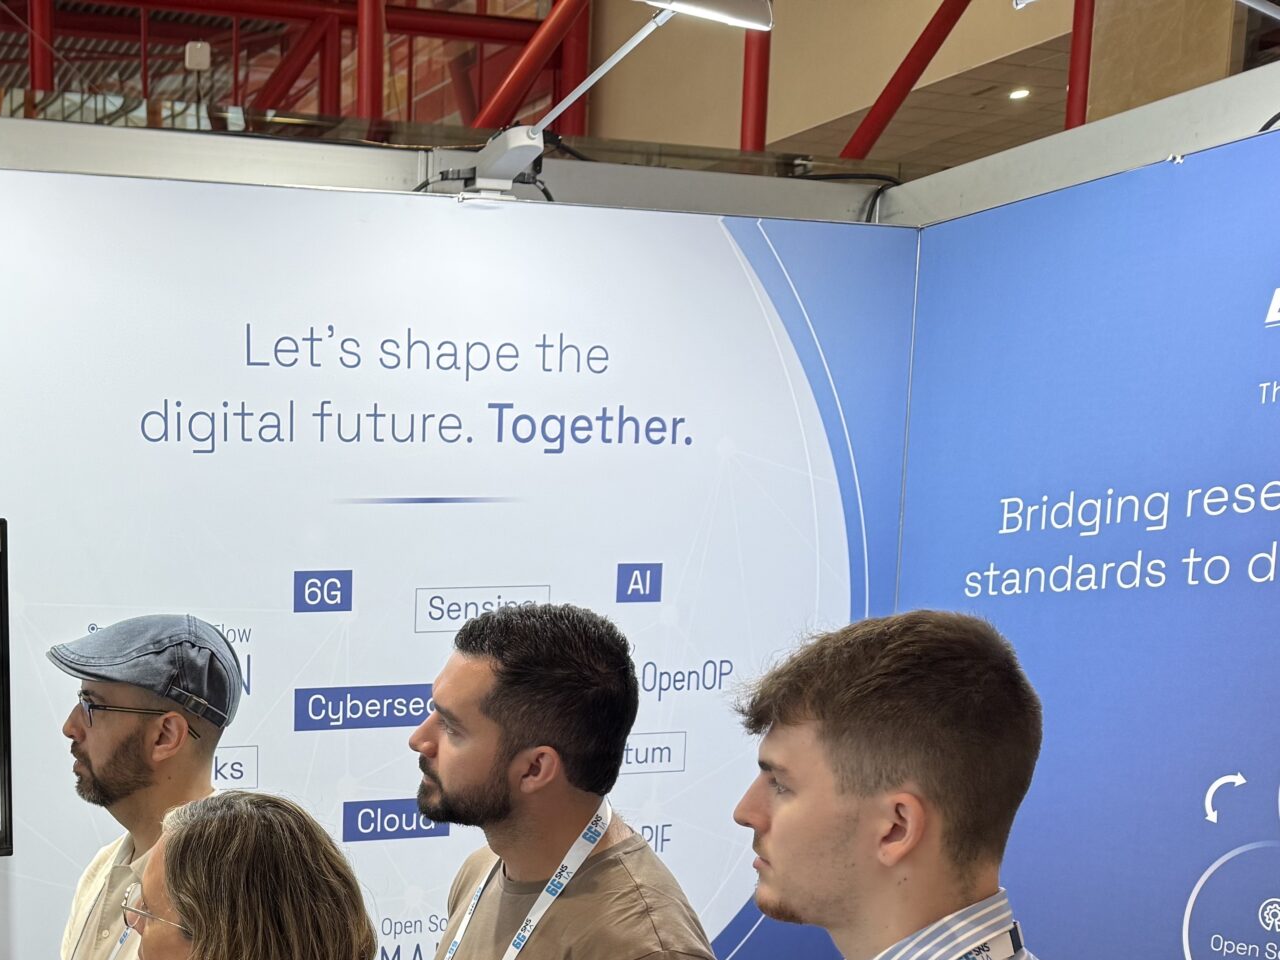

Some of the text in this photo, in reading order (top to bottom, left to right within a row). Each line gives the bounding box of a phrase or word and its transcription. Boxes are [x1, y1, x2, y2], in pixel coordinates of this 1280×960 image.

[245, 323, 609, 381] Let's shape the
[140, 399, 693, 454] digital future. Together.
[999, 488, 1169, 536] Bridging
[627, 570, 651, 595] AI
[964, 550, 1167, 598] standards
[1181, 548, 1231, 585] to
[303, 578, 342, 605] 6G
[642, 660, 733, 702] OpenOP
[581, 825, 602, 845] 6G
[545, 864, 568, 897] 6G SNS
[381, 917, 423, 940] Open
[512, 932, 526, 950] 6G
[972, 942, 990, 957] SNS
[1210, 934, 1260, 958] Open
